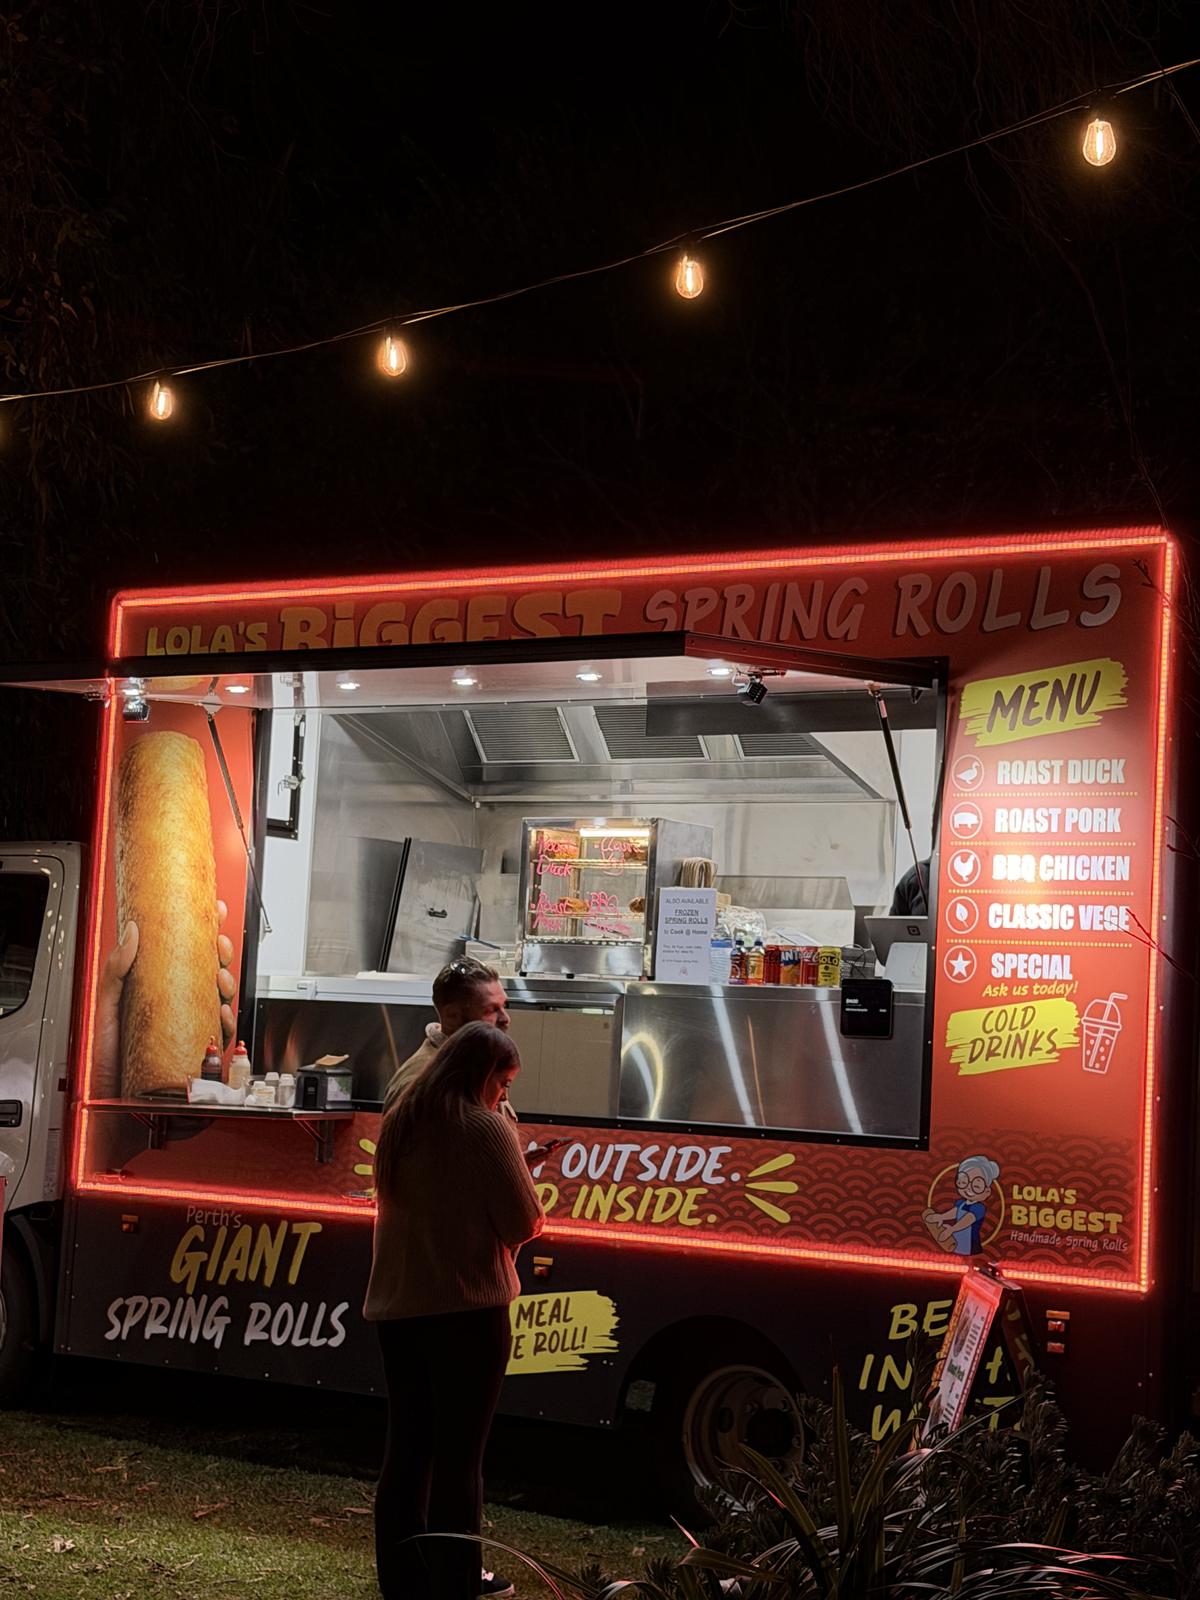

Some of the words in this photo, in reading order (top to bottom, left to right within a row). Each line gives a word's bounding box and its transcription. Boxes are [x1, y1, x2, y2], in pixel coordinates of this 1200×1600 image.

[146, 620, 269, 656] LOLA'S
[645, 577, 869, 642] SPRING
[895, 563, 1123, 637] ROLLS
[986, 670, 1101, 733] MENU
[997, 760, 1063, 785] ROAST
[1067, 758, 1127, 785] DUCK
[995, 808, 1061, 833] ROAST
[1065, 807, 1121, 833] PORK
[992, 855, 1038, 883] BBQ
[1039, 855, 1130, 881] CHICKEN
[664, 917, 689, 925] SPRING
[689, 917, 708, 925] ROLLS
[675, 908, 699, 916] FROZEN
[988, 903, 1074, 930] CLASSIC
[1078, 905, 1130, 931] VEGE
[991, 952, 1073, 981] SPECIAL
[982, 982, 1009, 998] Ask
[1012, 984, 1028, 996] us
[1033, 981, 1078, 997] today!
[982, 1006, 1036, 1035] COLD
[967, 1028, 1059, 1064] DRINKS
[561, 1143, 742, 1184] OUTSIDE.
[571, 1183, 717, 1226] INSIDE.
[1012, 1184, 1077, 1205] LOLA'S
[186, 1204, 243, 1229] Perth's
[1010, 1231, 1061, 1246] Handmade
[1066, 1236, 1099, 1252] Spring
[1102, 1238, 1129, 1252] Rolls
[169, 1219, 323, 1295] GIANT
[104, 1294, 232, 1350] SPRING
[243, 1301, 350, 1348] ROLLS
[515, 1297, 574, 1329] MEAL
[533, 1326, 588, 1356] ROLL!
